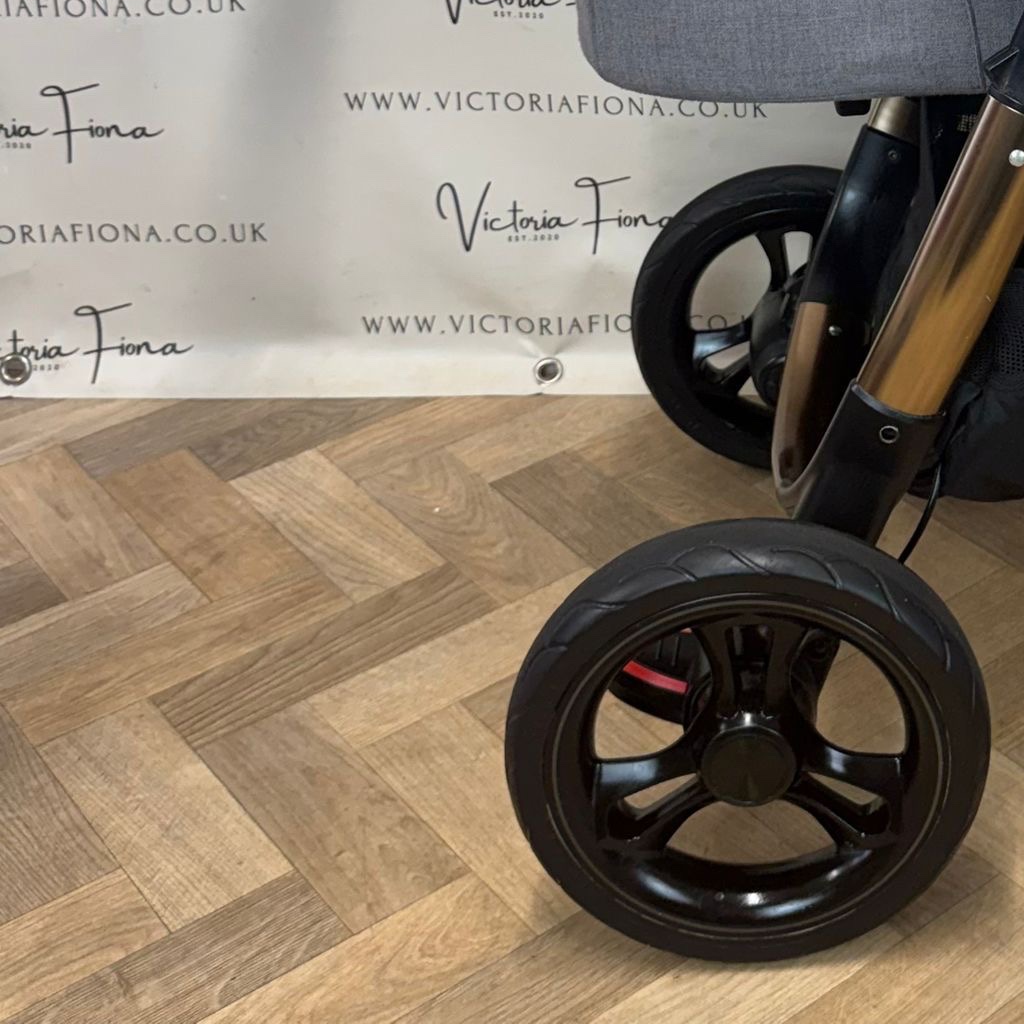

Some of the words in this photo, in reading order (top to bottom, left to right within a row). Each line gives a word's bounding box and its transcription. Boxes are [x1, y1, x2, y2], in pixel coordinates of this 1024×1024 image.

[40, 83, 164, 164] Fiona
[344, 91, 768, 119] WWW.VICTORIAFIONA.CO.UK
[436, 181, 579, 252] Victoria
[74, 303, 194, 385] Fiona
